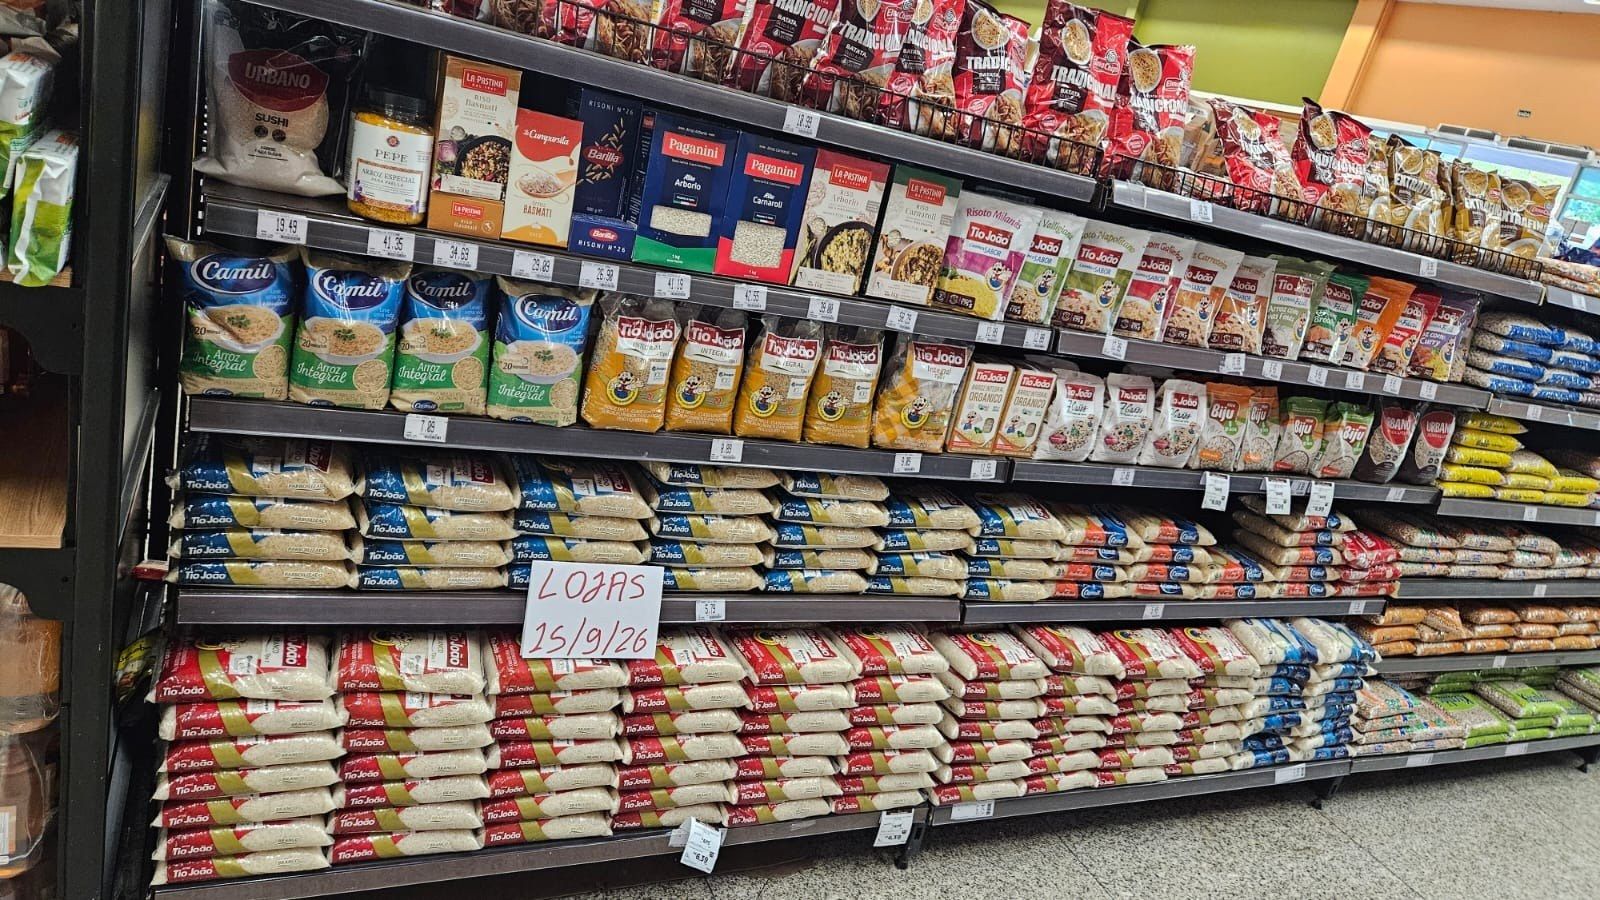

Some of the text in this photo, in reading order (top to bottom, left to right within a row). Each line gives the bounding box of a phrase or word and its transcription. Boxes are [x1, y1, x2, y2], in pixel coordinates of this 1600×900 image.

[244, 62, 310, 90] URBANO
[466, 72, 504, 90] LA PASTINA
[589, 100, 614, 111] RISONI
[255, 112, 289, 128] SUSHI
[529, 129, 570, 146] Cumparsita
[587, 148, 620, 163] Barilla
[668, 137, 719, 160] Paganini
[375, 149, 409, 163] PEPE
[361, 167, 416, 185] ARROZ ESPECIAL
[751, 159, 798, 179] Paganini
[834, 169, 868, 185] LA PASTINA
[674, 178, 702, 191] Arborio
[911, 183, 943, 199] LA PASTINA
[752, 195, 783, 209] Carnaroli
[523, 204, 552, 219] BASMATI
[275, 217, 298, 234] 19.49
[966, 207, 1022, 231] Risoto Milanês
[592, 229, 616, 240] Barilla
[969, 226, 1009, 246] Tio João
[383, 235, 404, 251] 41.35
[578, 239, 605, 250] RISONI
[1034, 240, 1060, 254] João
[449, 245, 470, 261] 34.69
[1081, 248, 1119, 266] Tio João
[202, 261, 273, 282] Camil
[1147, 262, 1170, 274] João
[1191, 271, 1214, 284] João
[322, 275, 384, 299] Camil
[415, 278, 472, 299] Camil
[667, 279, 684, 292] 41.19
[1236, 281, 1257, 293] João
[1277, 280, 1293, 291] Tio
[523, 300, 578, 322] Camil
[620, 323, 674, 345] Tio João
[690, 326, 741, 349] Tio João
[301, 339, 311, 349] 20
[401, 342, 410, 351] 20
[767, 339, 815, 359] Tio João
[1419, 338, 1441, 347] Curry
[214, 350, 240, 361] Arroz
[831, 346, 846, 359] Tio
[915, 347, 964, 365] Tio João
[193, 352, 247, 373] Integral
[316, 361, 341, 373] Arroz
[416, 362, 440, 374] Arroz
[297, 363, 348, 385] Integral
[398, 366, 447, 385] Integral
[976, 371, 1007, 386] Tio João
[517, 382, 541, 392] Arroz
[1021, 376, 1052, 390] Tio João
[497, 384, 545, 402] Integral
[1076, 389, 1093, 400] João
[1180, 396, 1198, 408] João
[1210, 404, 1235, 422] Biju
[1250, 406, 1268, 424] Biju
[1293, 420, 1313, 438] Biju
[1343, 426, 1365, 443] Biju
[186, 481, 229, 490] Tio João
[369, 488, 405, 500] Tio João
[525, 500, 556, 510] Tio João
[662, 499, 691, 508] Tio João
[191, 515, 233, 525] Tio João
[783, 509, 810, 518] Tio João
[536, 567, 646, 604] LOJAS
[528, 616, 649, 656] 15/9/26
[634, 675, 661, 683] Tio João
[162, 686, 205, 697] Tio João
[182, 728, 224, 738] Tio João
[494, 726, 526, 737] Tio João
[744, 723, 770, 732] Tio João
[174, 759, 214, 771] Tio João
[625, 799, 653, 810] Tio João
